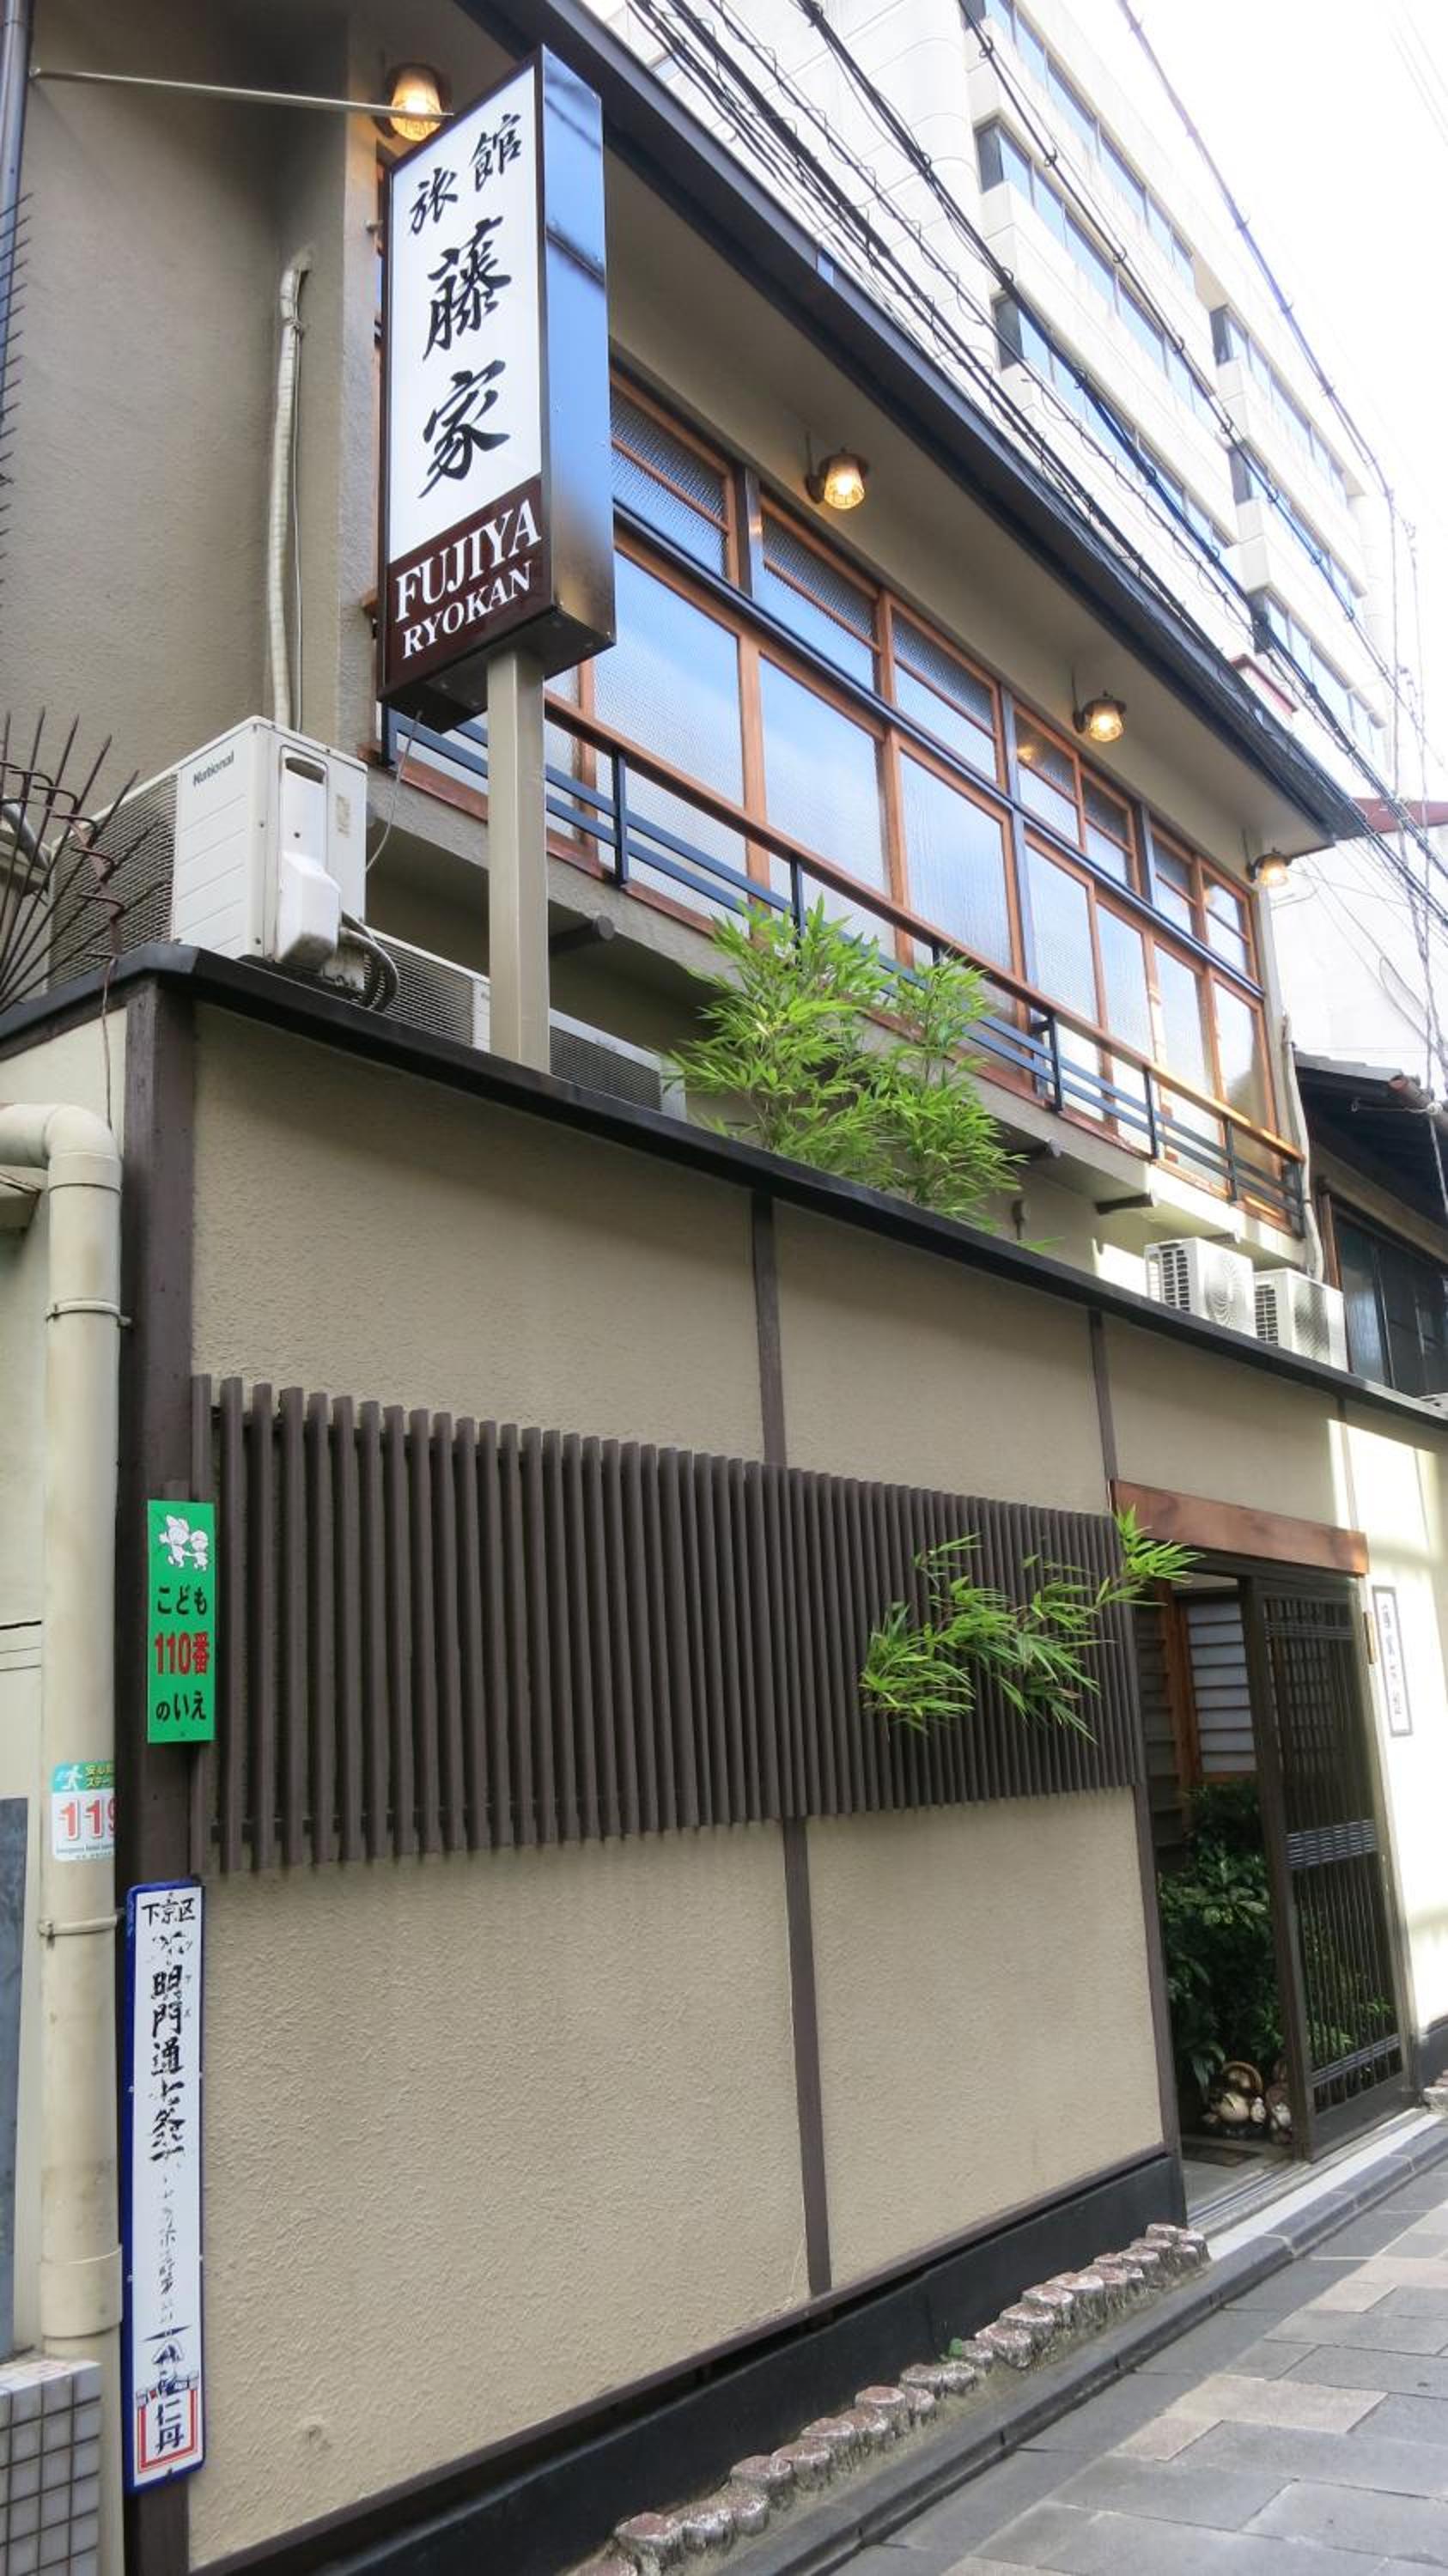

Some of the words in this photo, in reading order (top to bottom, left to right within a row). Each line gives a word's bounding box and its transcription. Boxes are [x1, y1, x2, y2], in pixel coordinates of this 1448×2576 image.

[409, 113, 522, 235] 旅館
[417, 216, 512, 499] 藤家
[395, 498, 542, 623] FUJIYA
[402, 560, 532, 660] RYOKAN
[192, 749, 234, 787] National
[157, 1586, 207, 1615] こども
[155, 1631, 210, 1675] 110番
[155, 1690, 207, 1722] のいえ
[142, 1893, 196, 1927] 下京区
[155, 2399, 185, 2454] 仁丹
